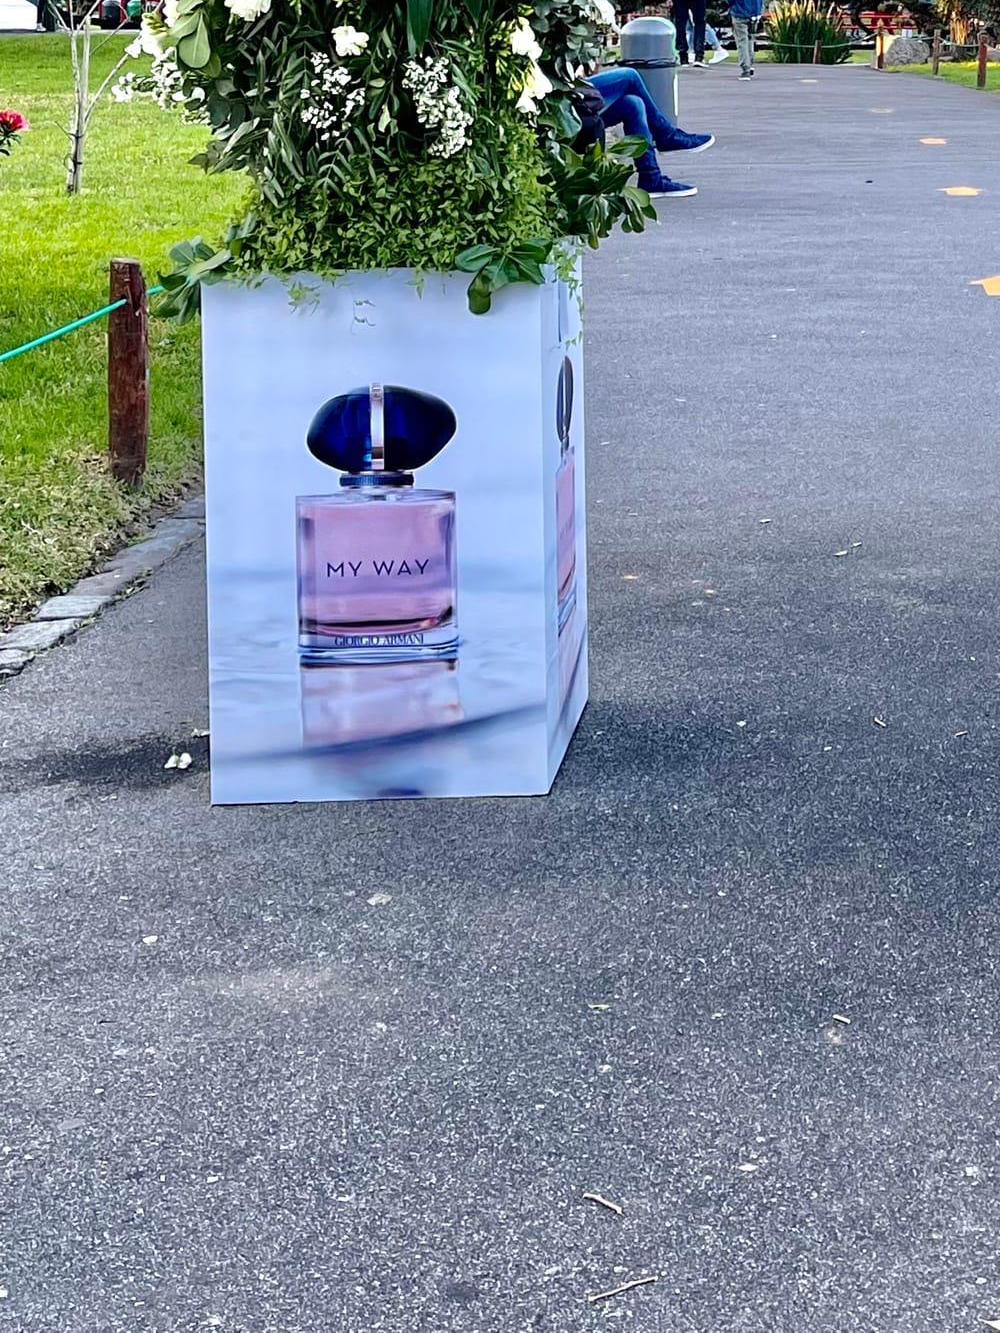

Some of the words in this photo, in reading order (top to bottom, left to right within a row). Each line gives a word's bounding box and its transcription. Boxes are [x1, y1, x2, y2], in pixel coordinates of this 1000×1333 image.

[327, 561, 362, 577] MY
[372, 559, 429, 577] WAY
[334, 635, 380, 647] GIORGIO
[383, 633, 424, 646] ARMANI
